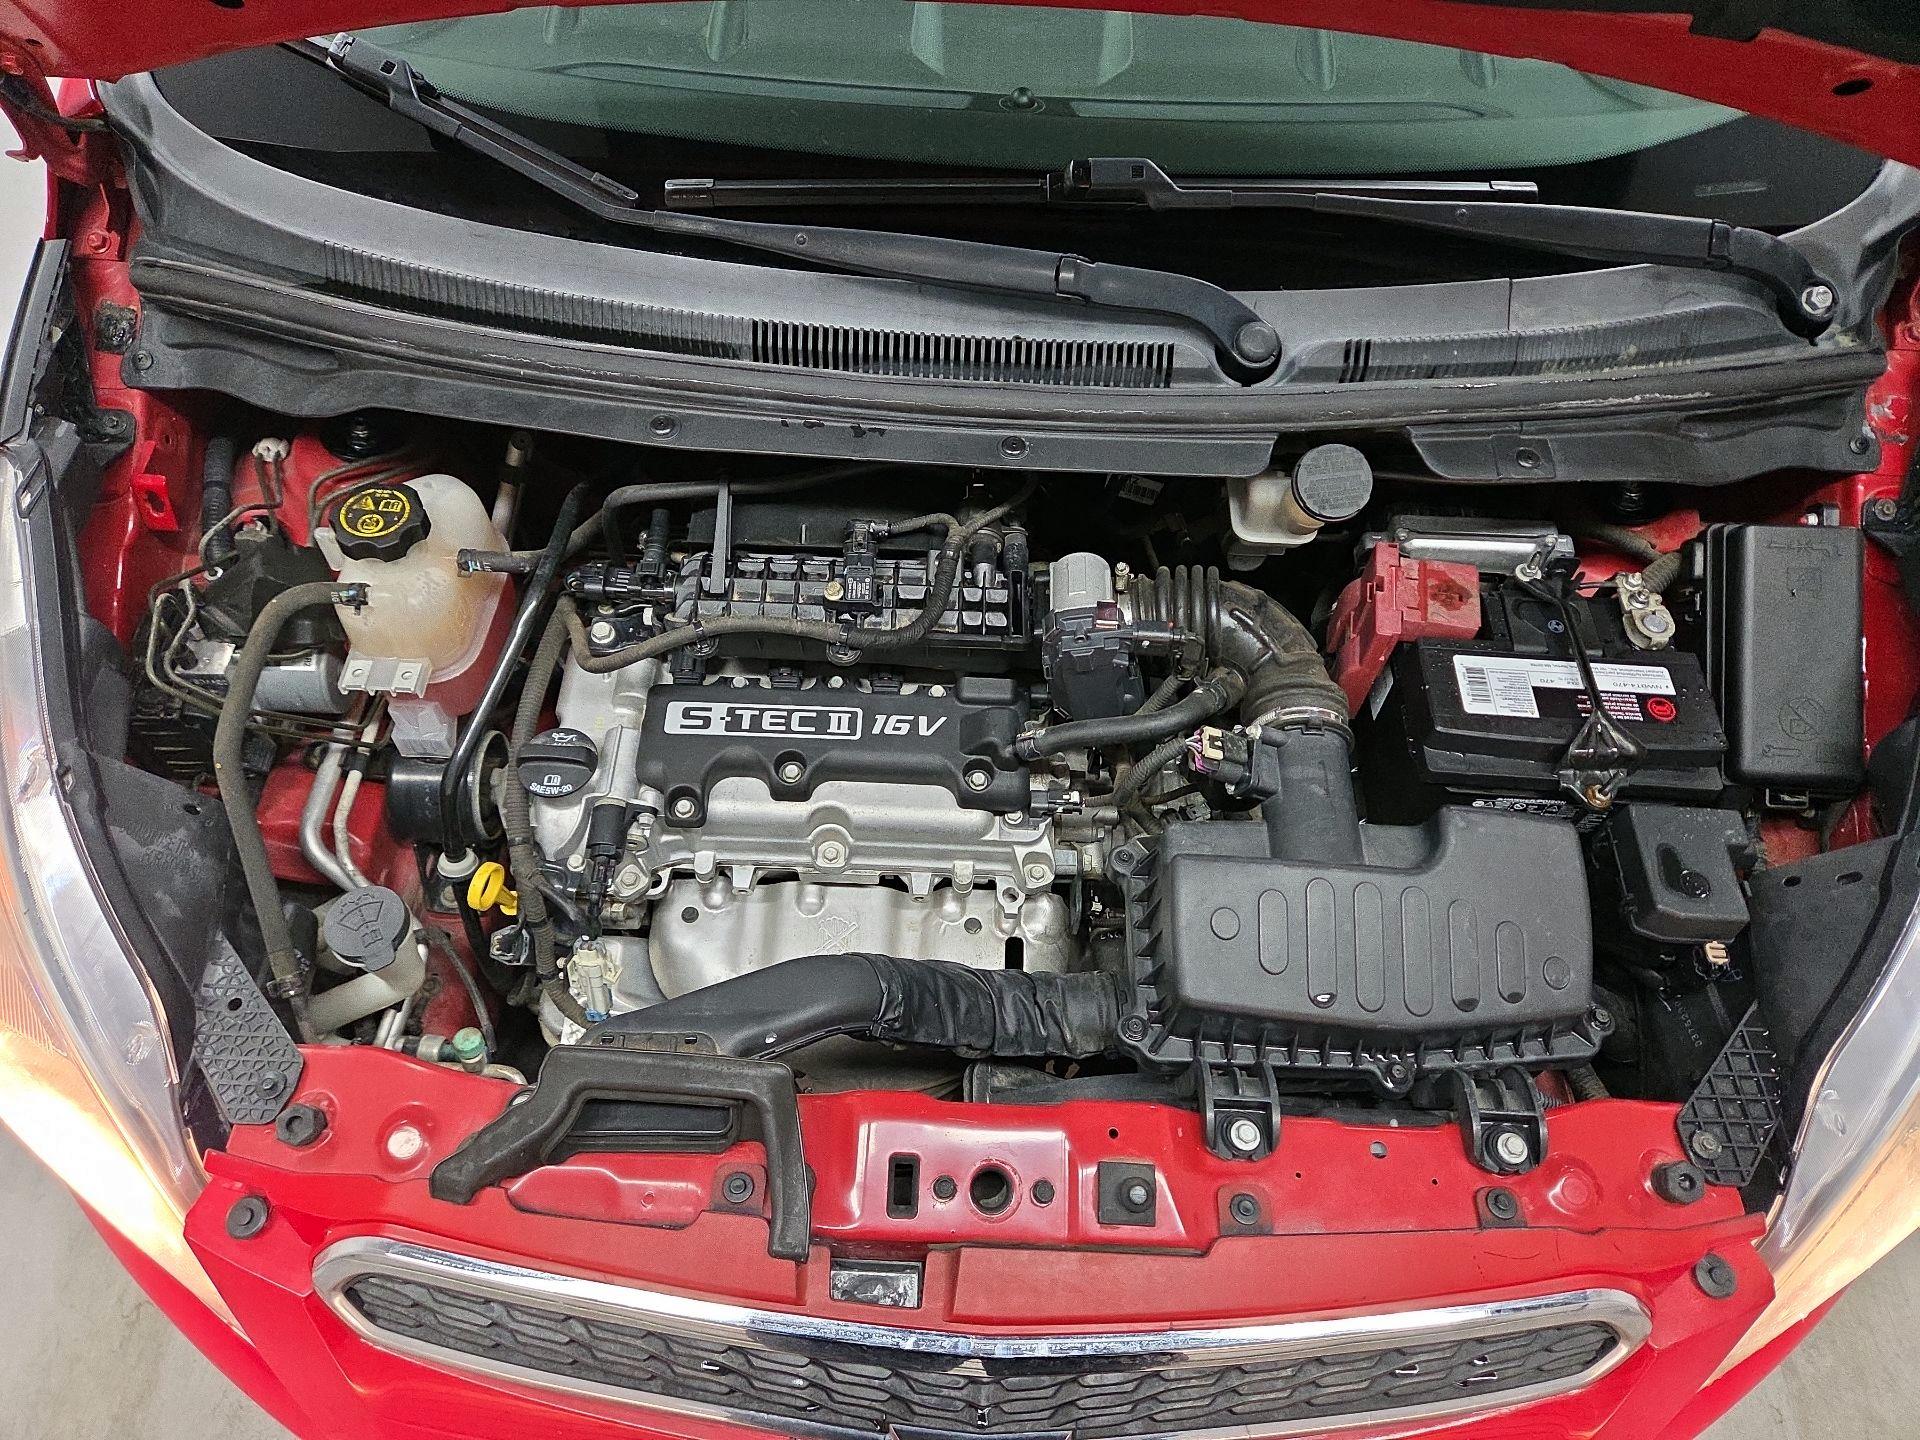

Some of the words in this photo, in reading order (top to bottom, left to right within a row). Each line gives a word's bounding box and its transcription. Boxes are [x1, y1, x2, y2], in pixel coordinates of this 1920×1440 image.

[679, 706, 818, 733] S-TEC
[827, 713, 853, 734] II
[871, 714, 948, 736] 16V
